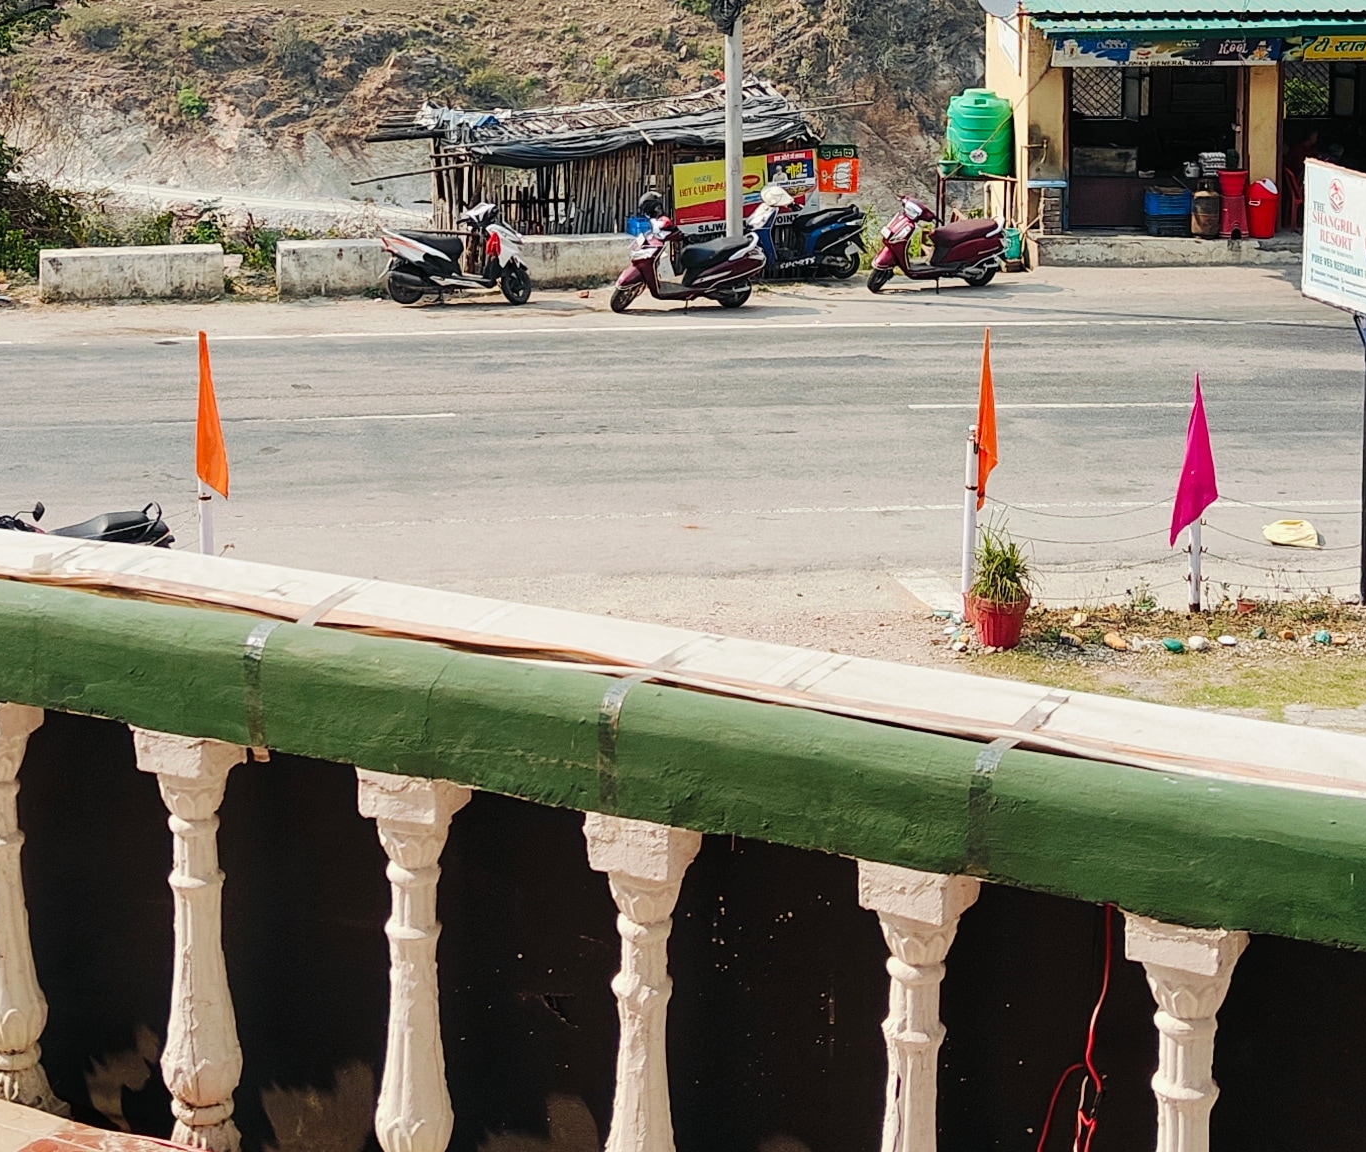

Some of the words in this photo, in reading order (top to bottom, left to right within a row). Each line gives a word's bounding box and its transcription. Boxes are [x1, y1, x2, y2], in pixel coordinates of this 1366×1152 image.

[1313, 201, 1325, 212] THE
[1312, 211, 1361, 237] SHANGRILA
[1319, 229, 1353, 251] RESORT
[780, 256, 816, 269] SPORTS
[1311, 253, 1323, 265] PURE
